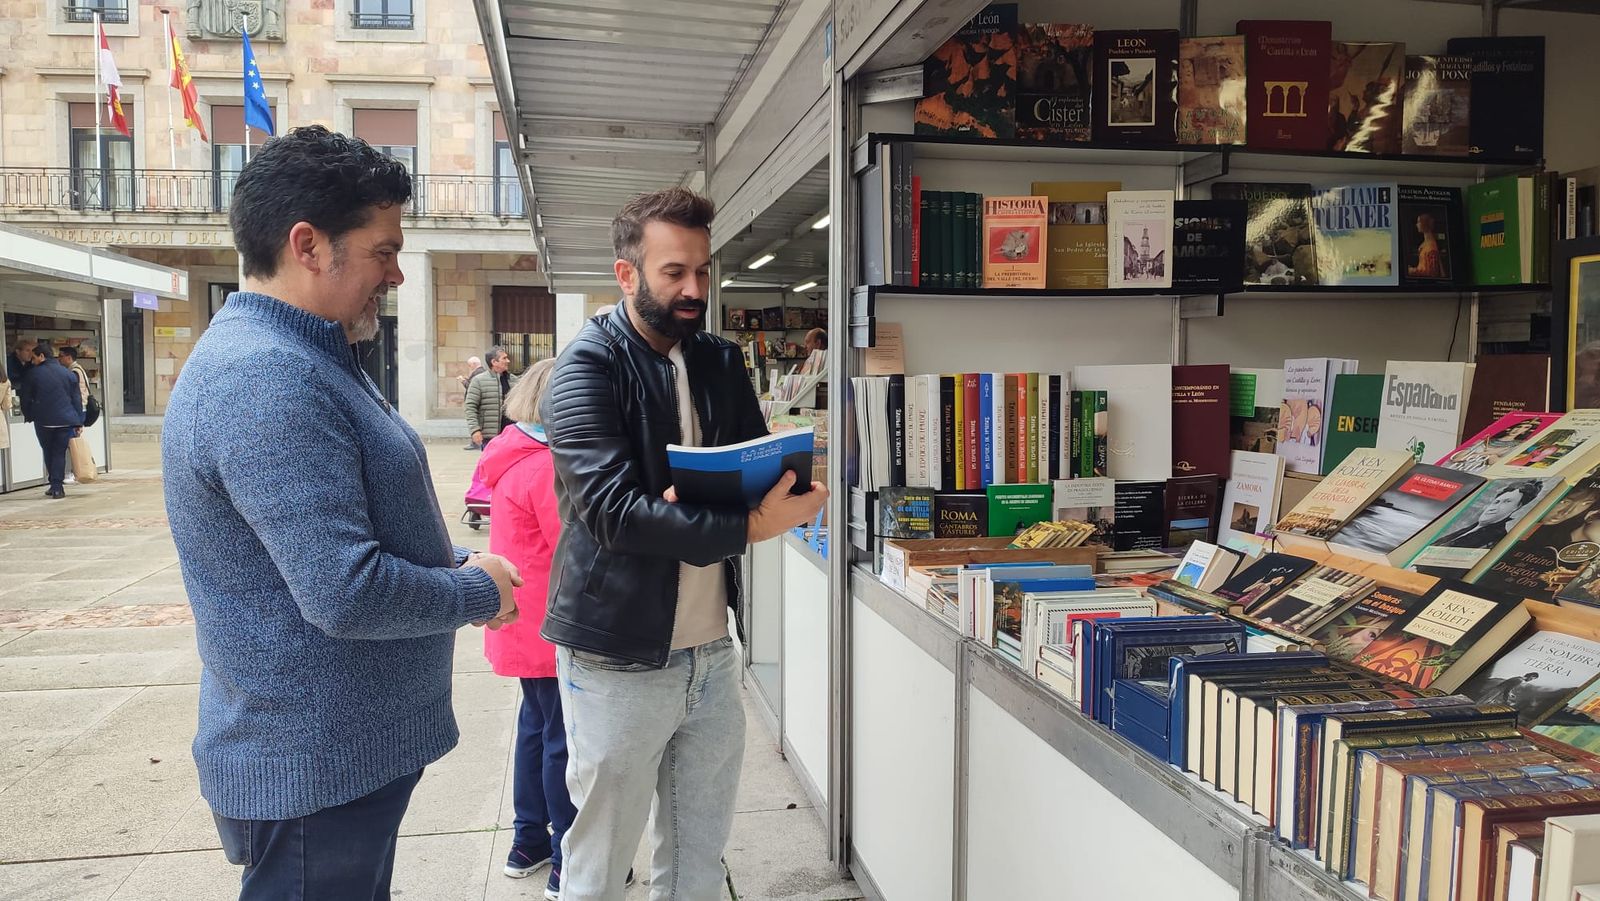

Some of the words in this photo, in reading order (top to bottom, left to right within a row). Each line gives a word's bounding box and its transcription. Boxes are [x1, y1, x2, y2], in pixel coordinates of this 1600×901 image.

[978, 12, 999, 24] León
[1117, 38, 1146, 47] LEON
[1472, 60, 1495, 72] astillos
[1034, 98, 1084, 122] Císter
[985, 200, 1044, 215] HISTORIA
[1315, 205, 1391, 230] TURNER
[186, 232, 222, 244] DEL
[1187, 233, 1202, 242] DE
[1480, 232, 1505, 248] ANDALUZ
[1358, 456, 1385, 467] KEN
[1337, 466, 1384, 478] FOLLETT
[1236, 482, 1262, 492] ZAMORA
[1312, 491, 1356, 504] ETERNIDAD
[940, 509, 978, 521] ROMA
[1522, 554, 1555, 566] Reino
[1493, 562, 1539, 578] Dragón
[1517, 577, 1538, 588] Oro
[1445, 602, 1470, 614] KEN
[1426, 608, 1472, 626] FOLLETT
[1430, 627, 1455, 639] BLANCO
[1528, 643, 1544, 652] LA
[1524, 658, 1572, 676] TIERRA
